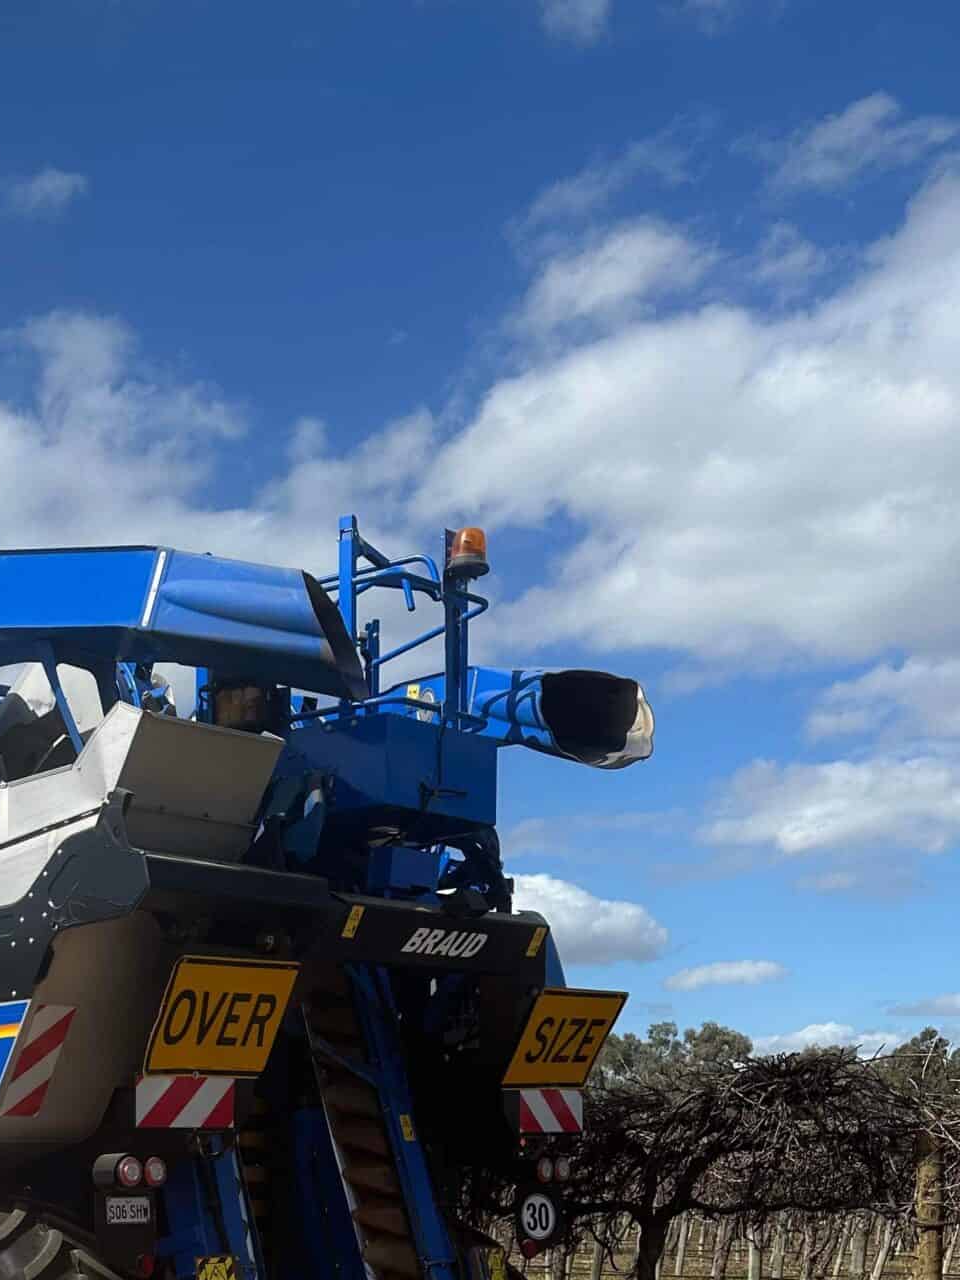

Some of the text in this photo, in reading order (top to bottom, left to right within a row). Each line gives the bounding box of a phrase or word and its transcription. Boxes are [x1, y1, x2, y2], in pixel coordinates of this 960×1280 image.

[400, 927, 488, 957] BRAUD
[163, 990, 277, 1048] OVER
[525, 1017, 608, 1064] SIZE
[527, 1202, 549, 1231] 30
